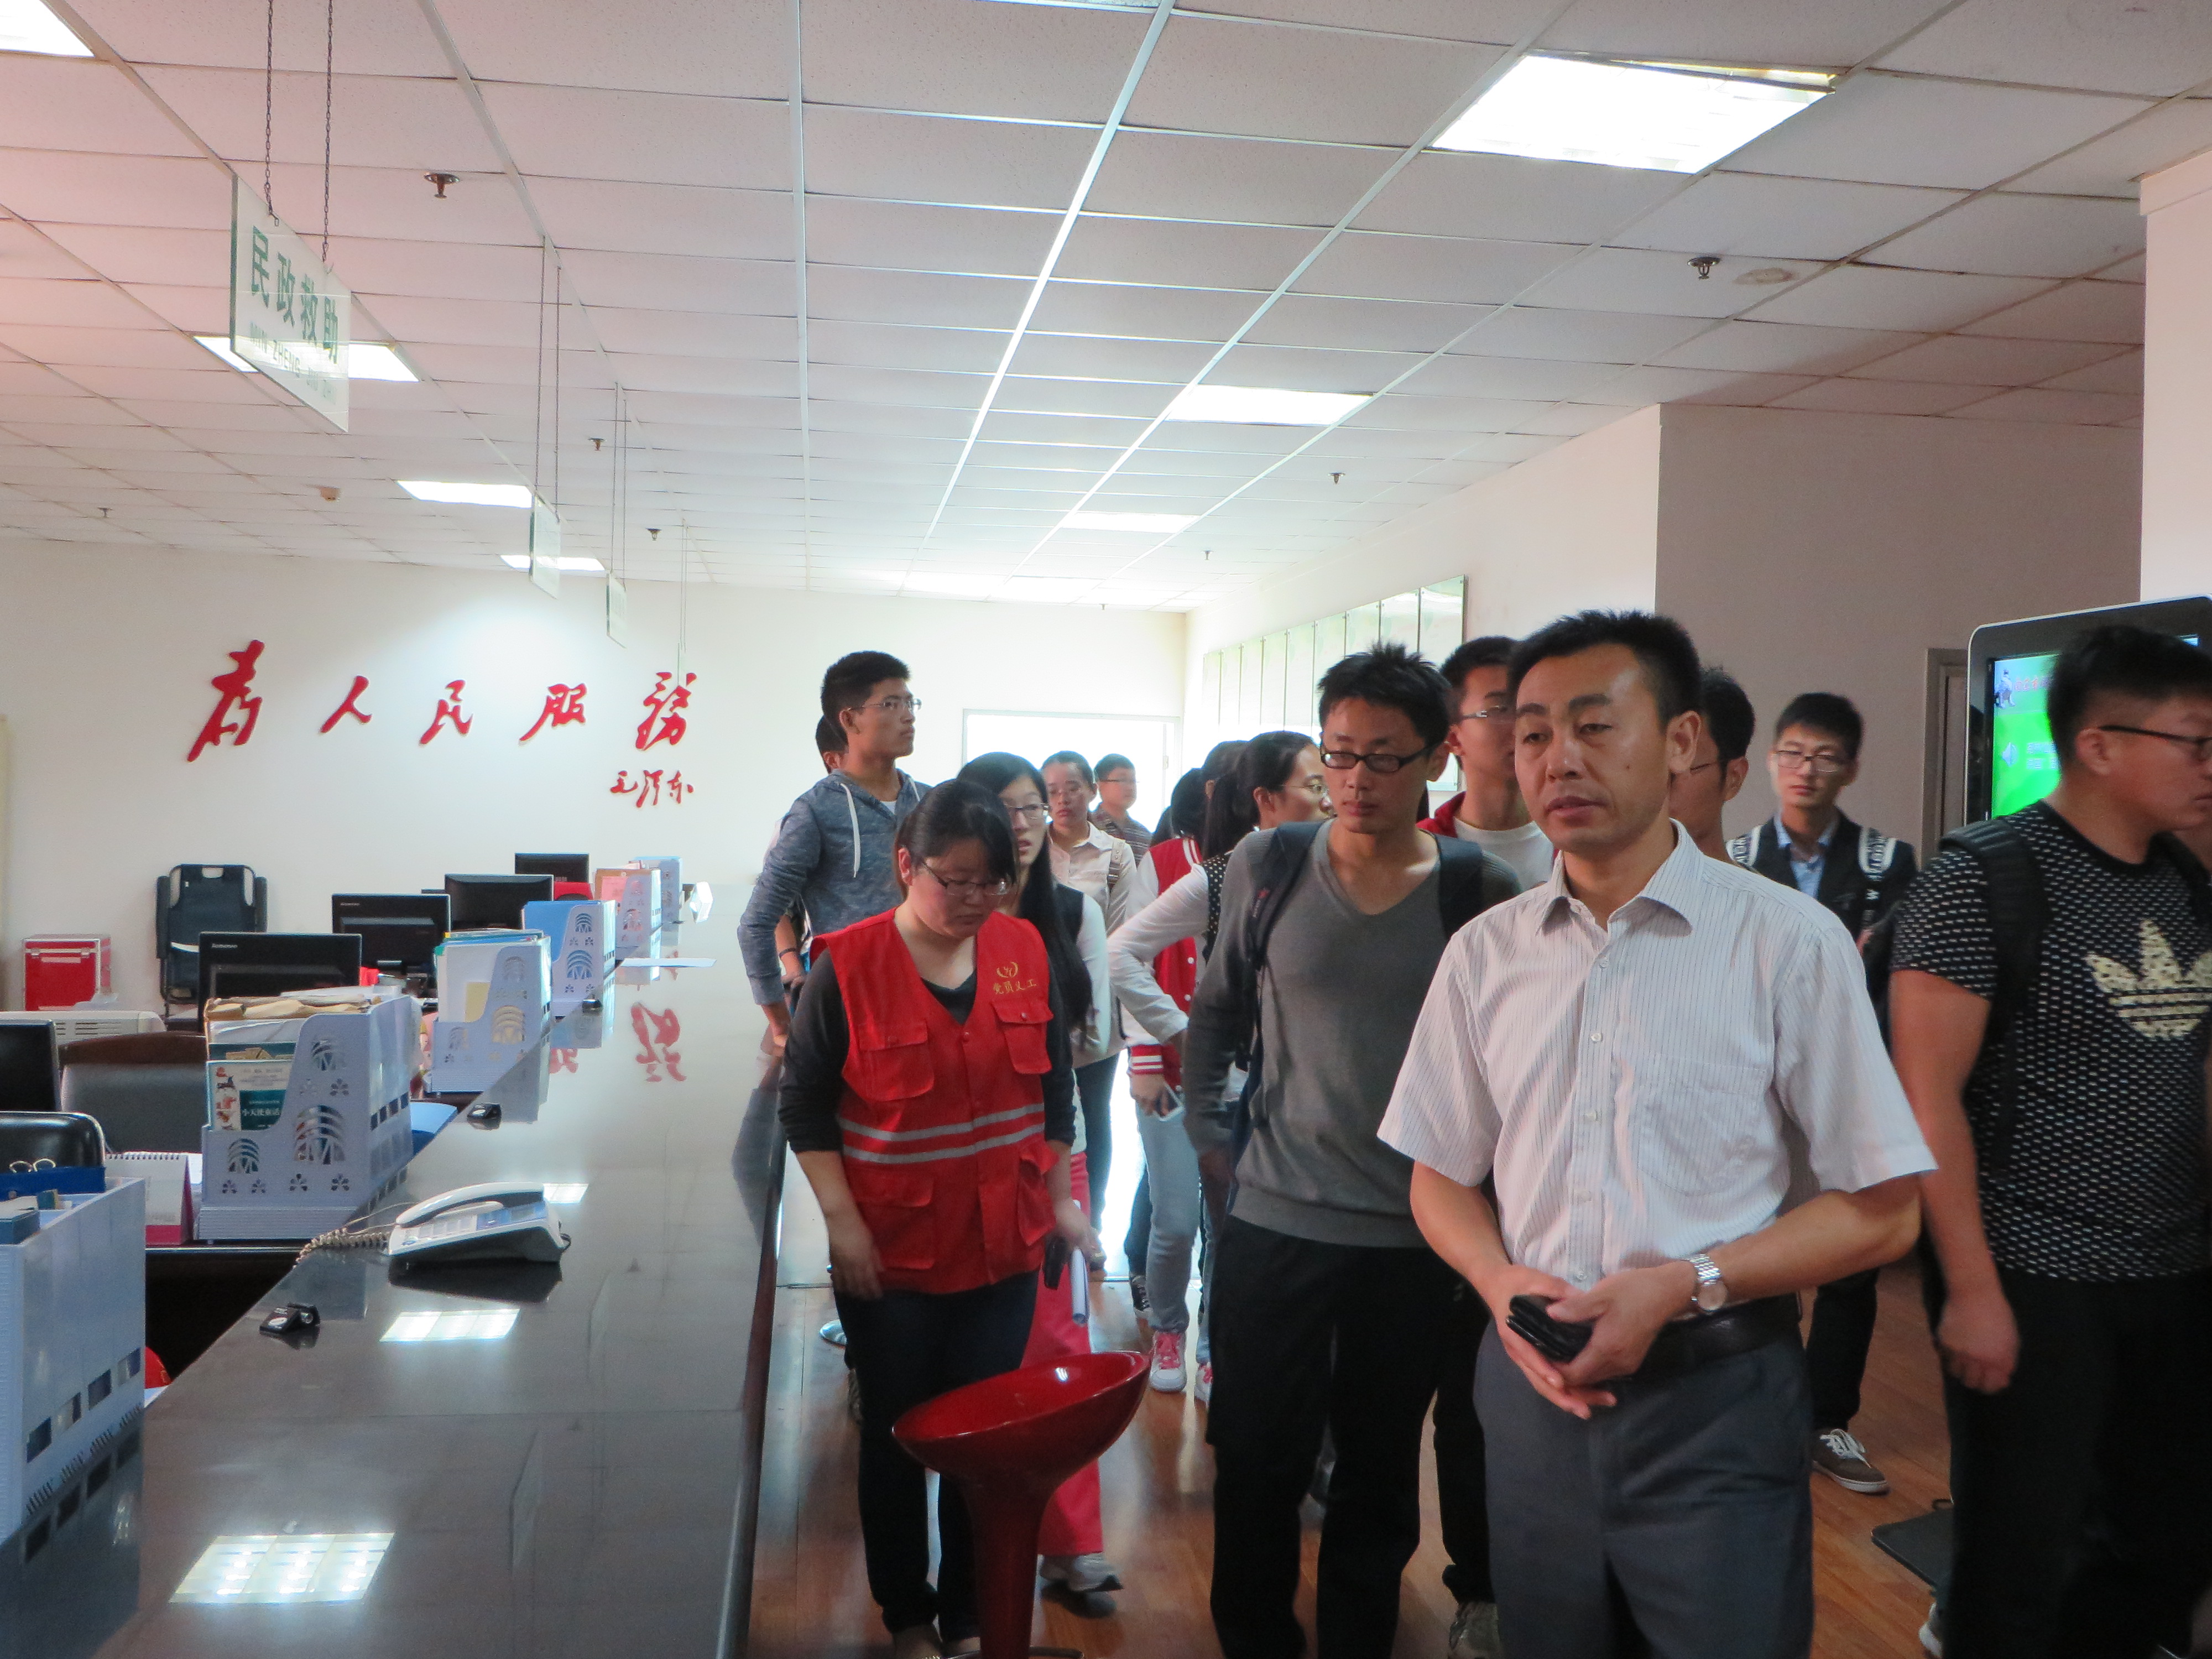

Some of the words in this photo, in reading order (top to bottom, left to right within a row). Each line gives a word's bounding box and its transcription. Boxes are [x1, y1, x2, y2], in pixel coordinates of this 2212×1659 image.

[252, 225, 338, 365] 民政救助
[273, 339, 300, 378] ZHENG
